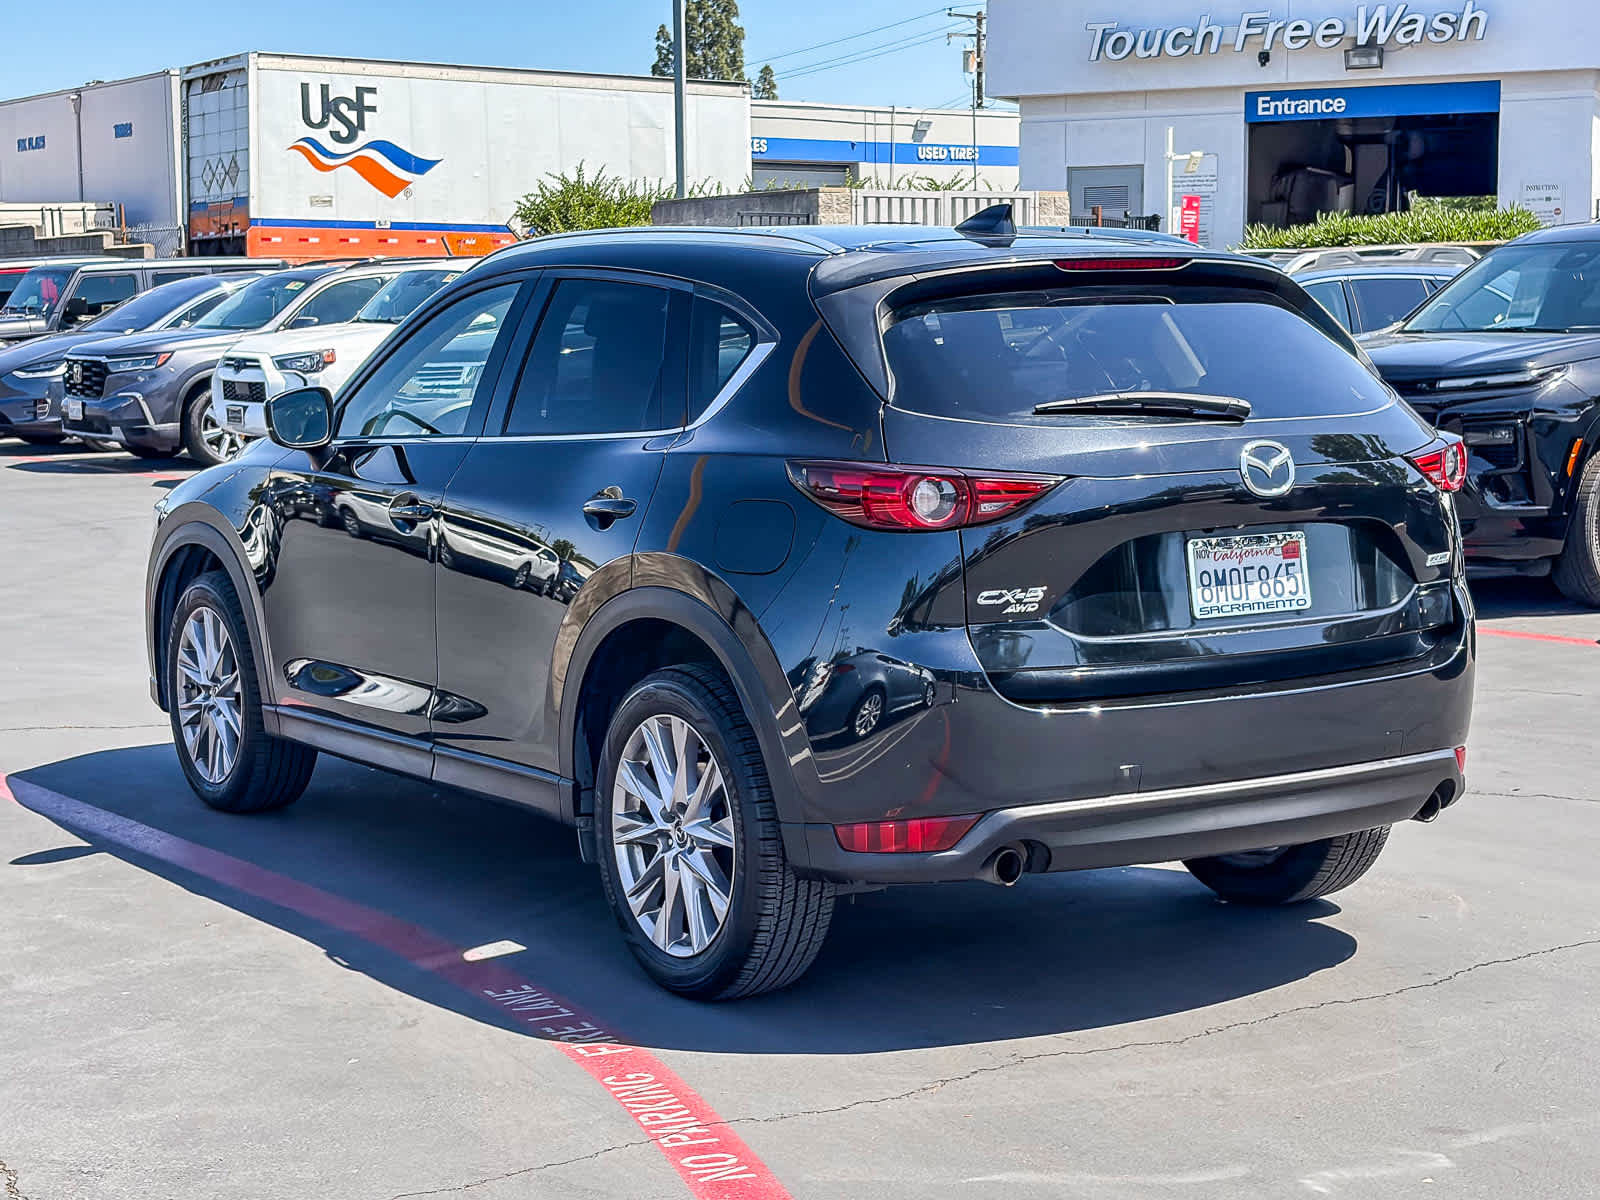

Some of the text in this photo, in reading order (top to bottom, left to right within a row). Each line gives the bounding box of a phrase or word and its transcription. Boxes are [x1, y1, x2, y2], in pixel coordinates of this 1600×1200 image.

[1085, 0, 1489, 62] Touch Free Wash
[300, 82, 378, 143] USF
[1256, 96, 1347, 117] Entrance
[917, 145, 980, 162] USED TIRES
[1196, 549, 1210, 560] NOV
[1213, 547, 1277, 564] California
[977, 586, 1047, 604] CX-5
[1002, 602, 1039, 614] AWD
[1199, 598, 1308, 616] SACRAMENTO
[483, 984, 757, 1183] NO PARKING FIRE LANE
